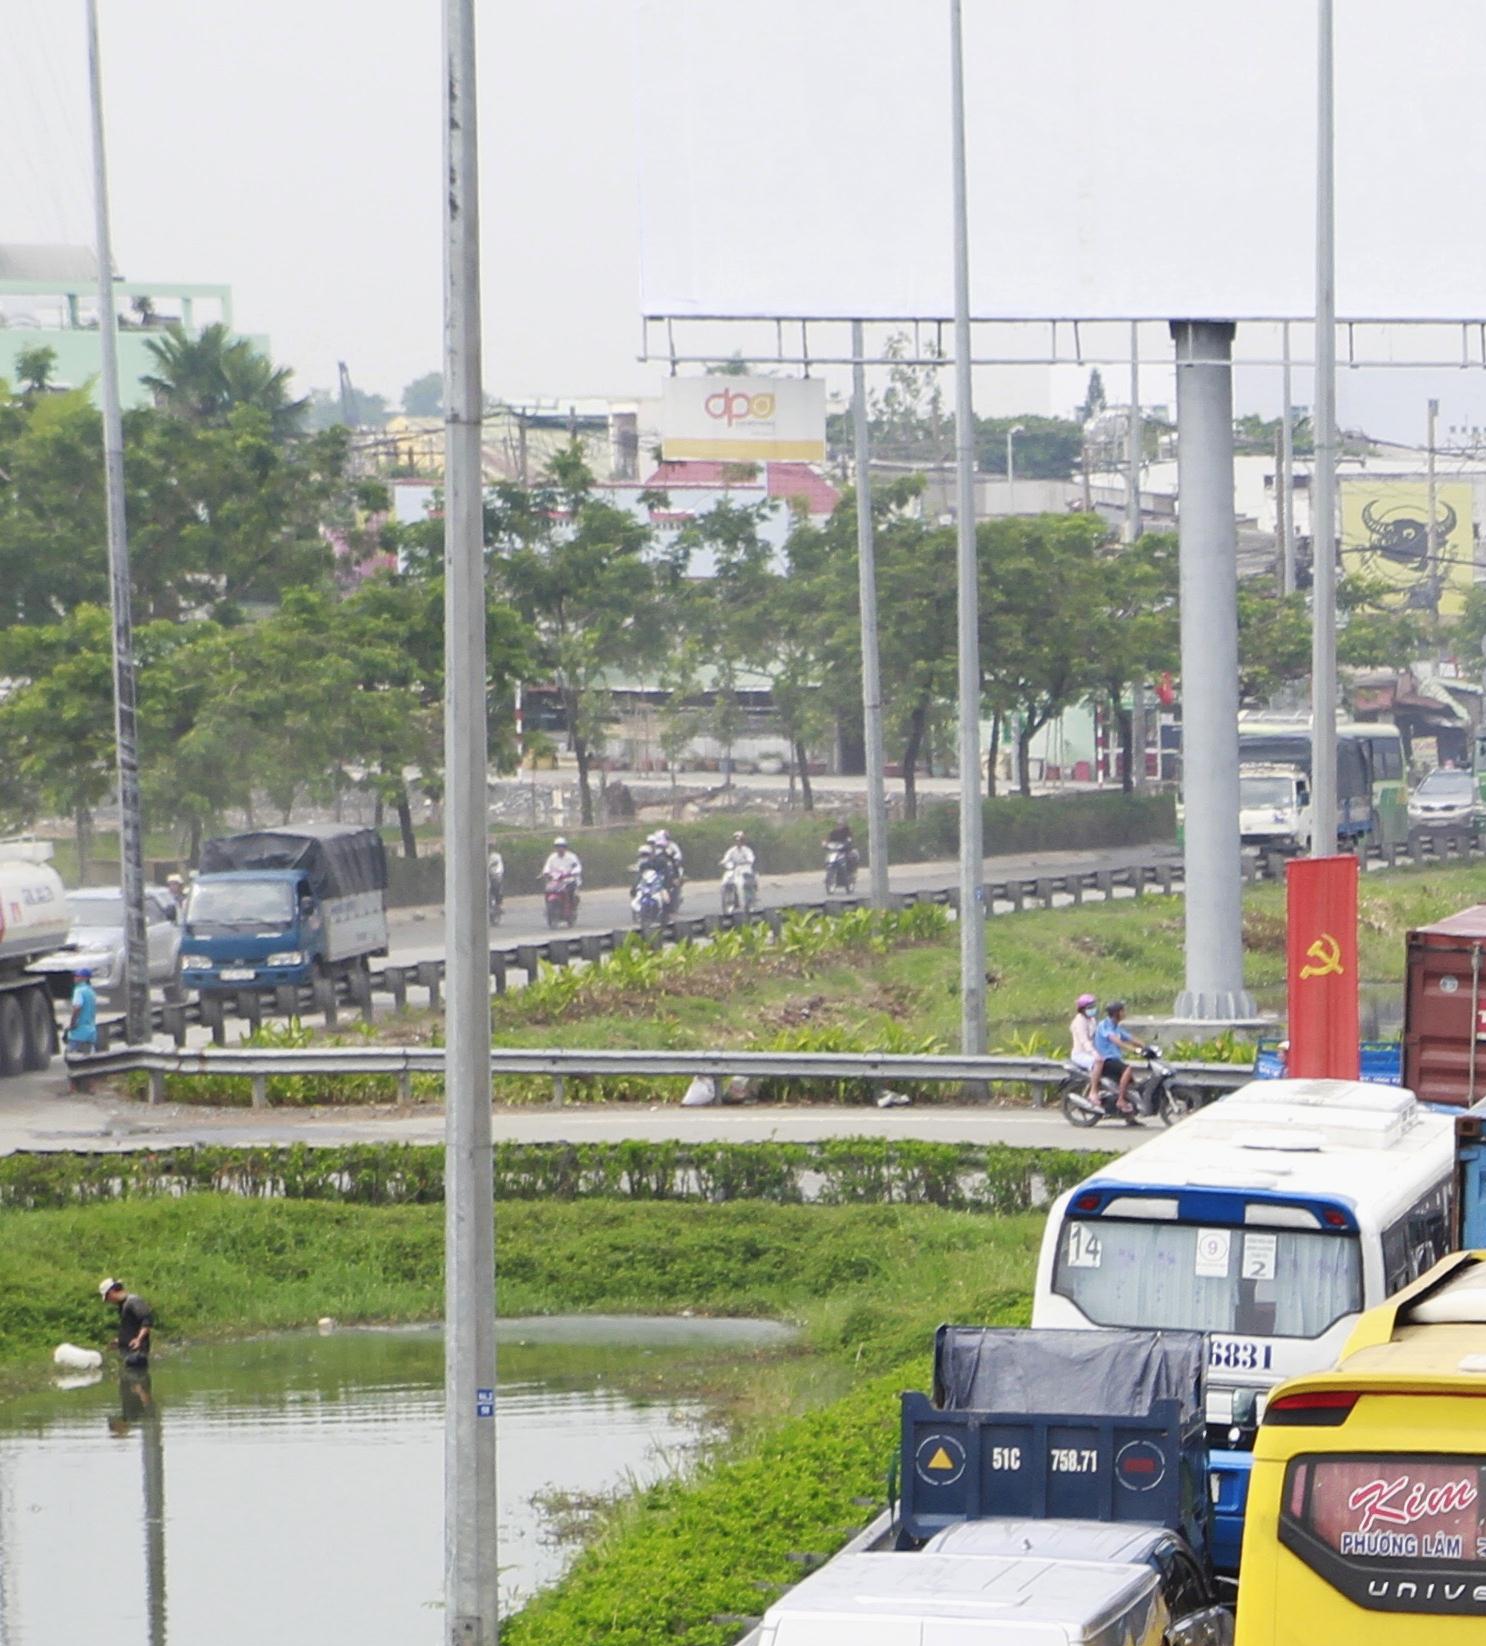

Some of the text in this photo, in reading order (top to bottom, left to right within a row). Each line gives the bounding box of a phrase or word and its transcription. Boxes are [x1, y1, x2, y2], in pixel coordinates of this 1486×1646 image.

[992, 1447, 1099, 1473] 51C 758.71
[1348, 1475, 1478, 1534] Kim
[1421, 1530, 1464, 1560] LÂM
